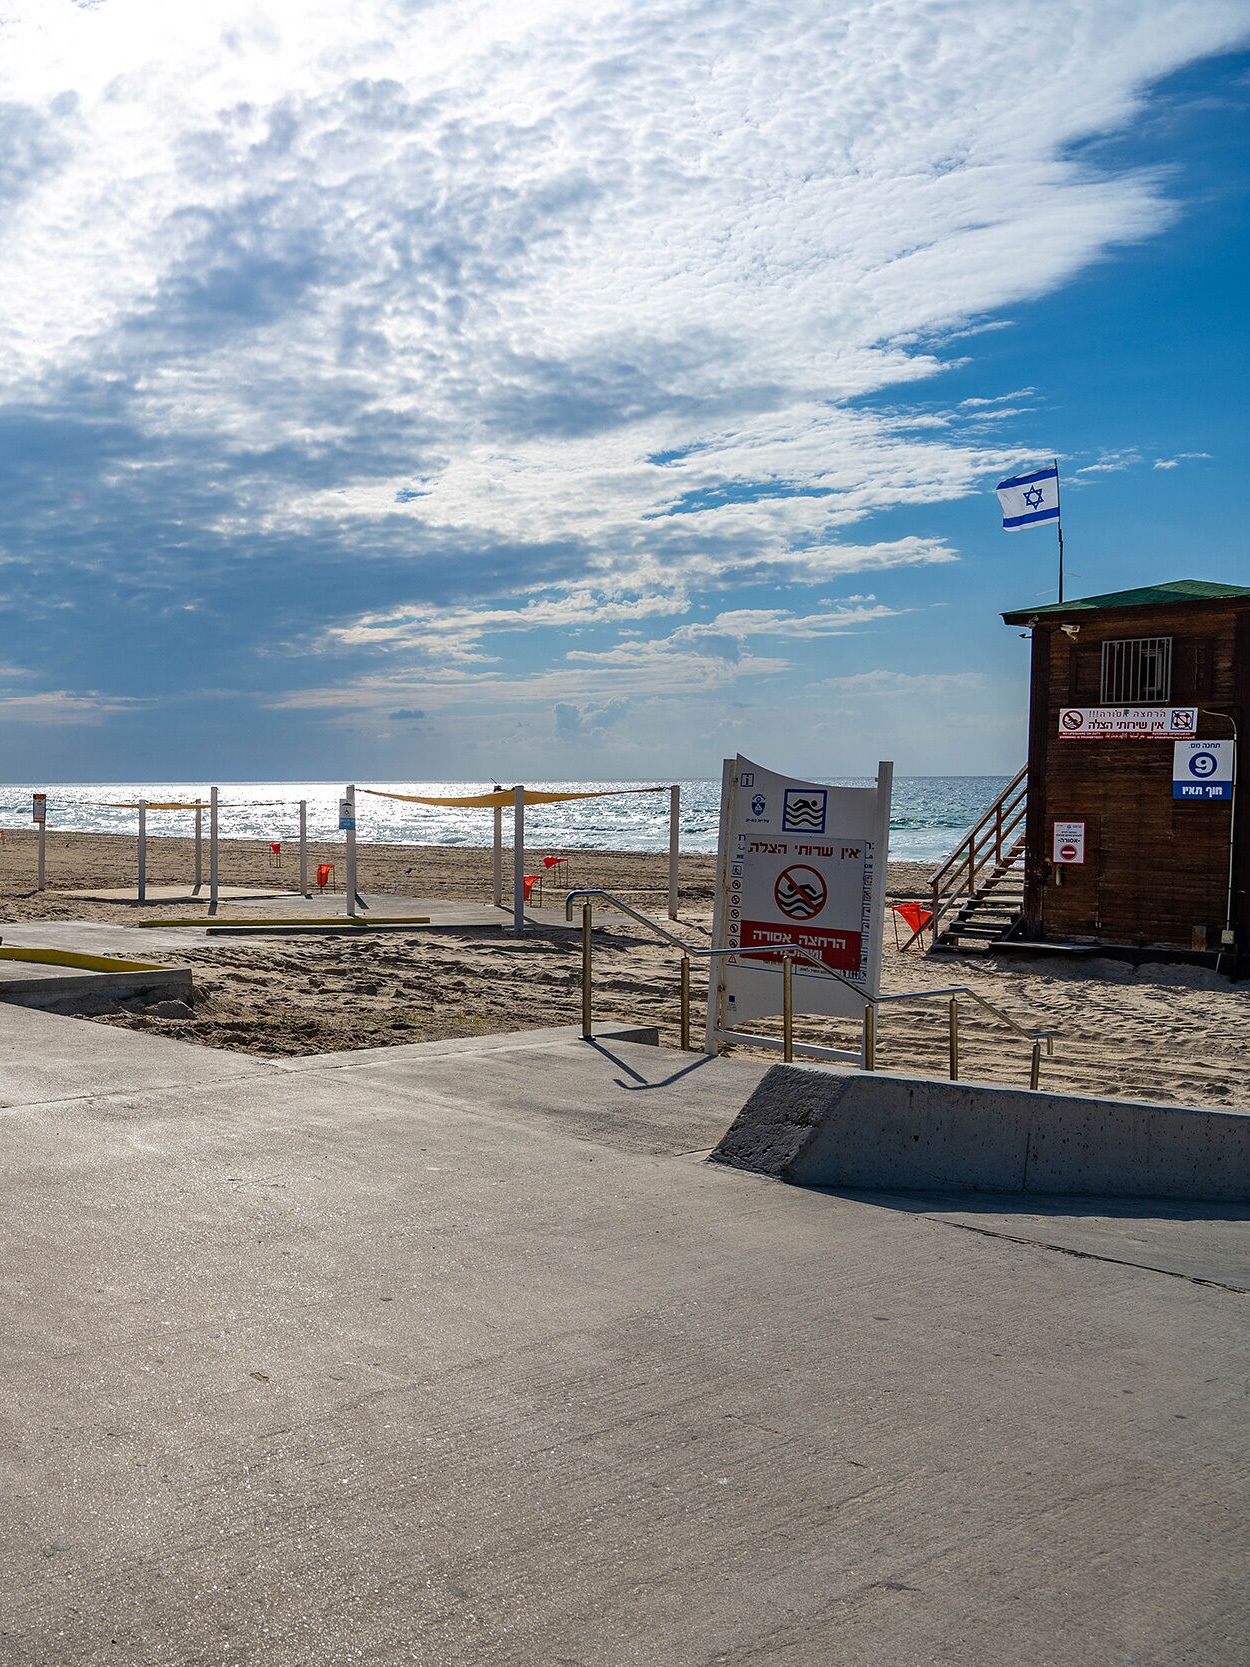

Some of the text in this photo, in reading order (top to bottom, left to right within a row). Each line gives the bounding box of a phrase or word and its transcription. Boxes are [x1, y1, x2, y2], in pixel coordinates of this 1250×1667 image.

[1133, 710, 1166, 718] הרחצה
[1088, 719, 1165, 731] אין שירותי הצלה
[1195, 756, 1214, 774] 9
[1205, 786, 1223, 798] חוף
[749, 842, 787, 854] הצלה
[794, 845, 833, 857] שרותי
[840, 847, 860, 859] אין
[753, 930, 846, 950] הרחצה אסורה
